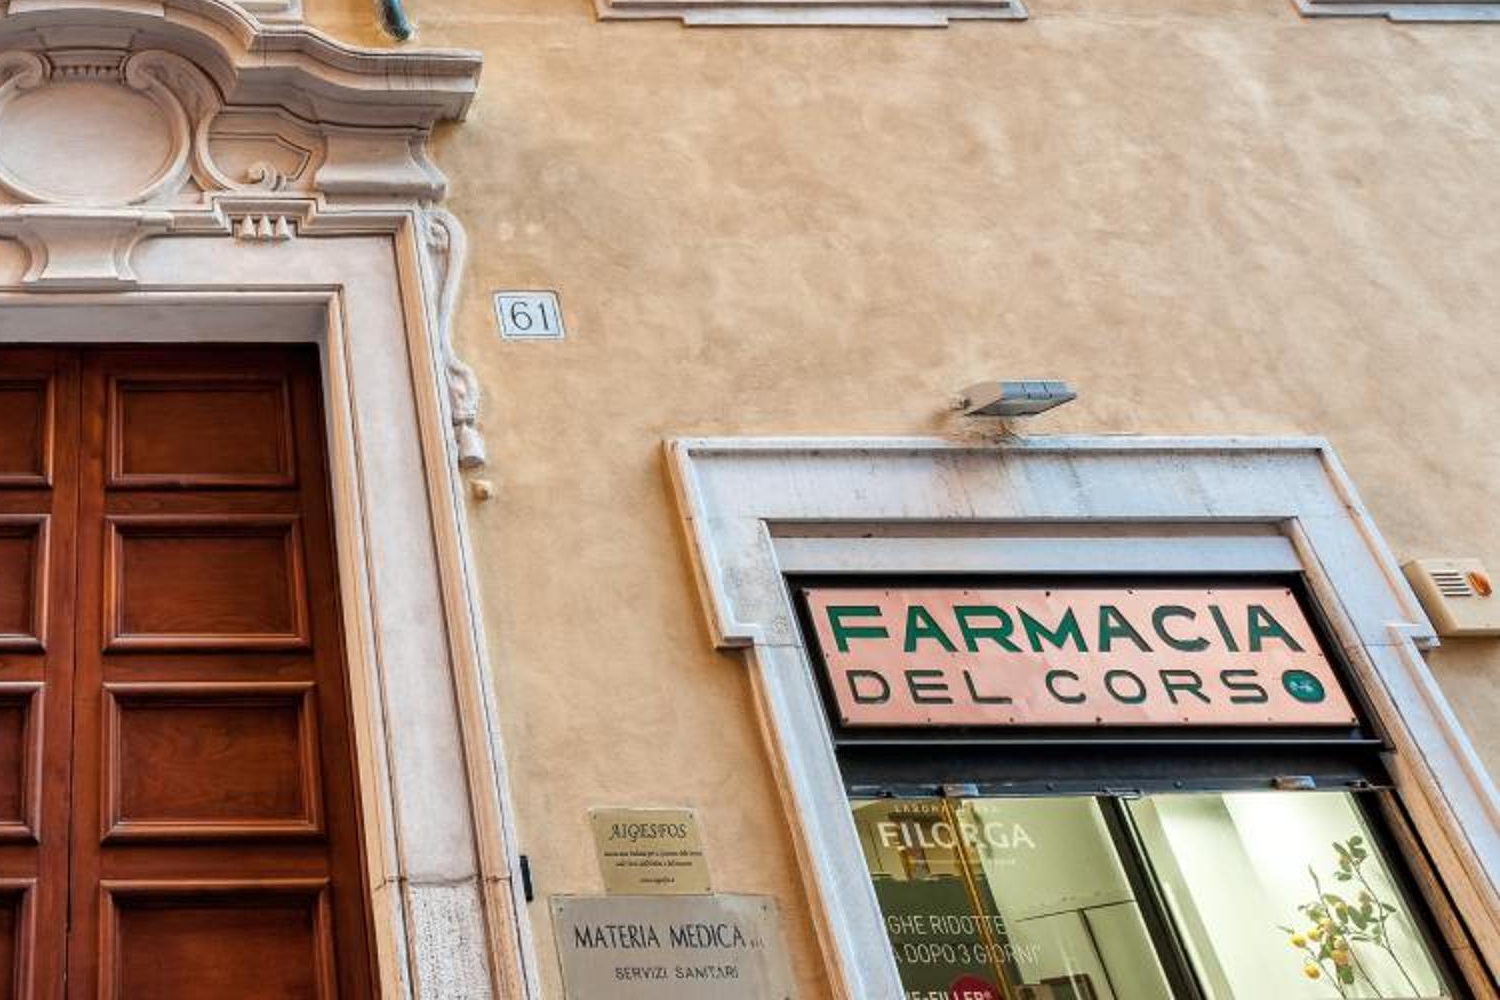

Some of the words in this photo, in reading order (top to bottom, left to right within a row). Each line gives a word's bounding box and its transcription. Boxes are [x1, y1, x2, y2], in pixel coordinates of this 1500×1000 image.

[510, 301, 549, 331] 61
[826, 605, 1307, 653] FARMACIA
[845, 669, 1013, 705] DEL
[1044, 669, 1326, 705] CORSO
[876, 822, 1036, 850] FILORGA
[573, 922, 661, 949] MATERIA
[668, 921, 747, 949] MEDICA
[886, 914, 927, 935] GHE
[930, 915, 1008, 935] RIDOTTE
[904, 943, 956, 964] DOPO
[958, 943, 971, 965] 3
[614, 966, 669, 981] SERVIZI
[675, 965, 739, 980] SANITARI
